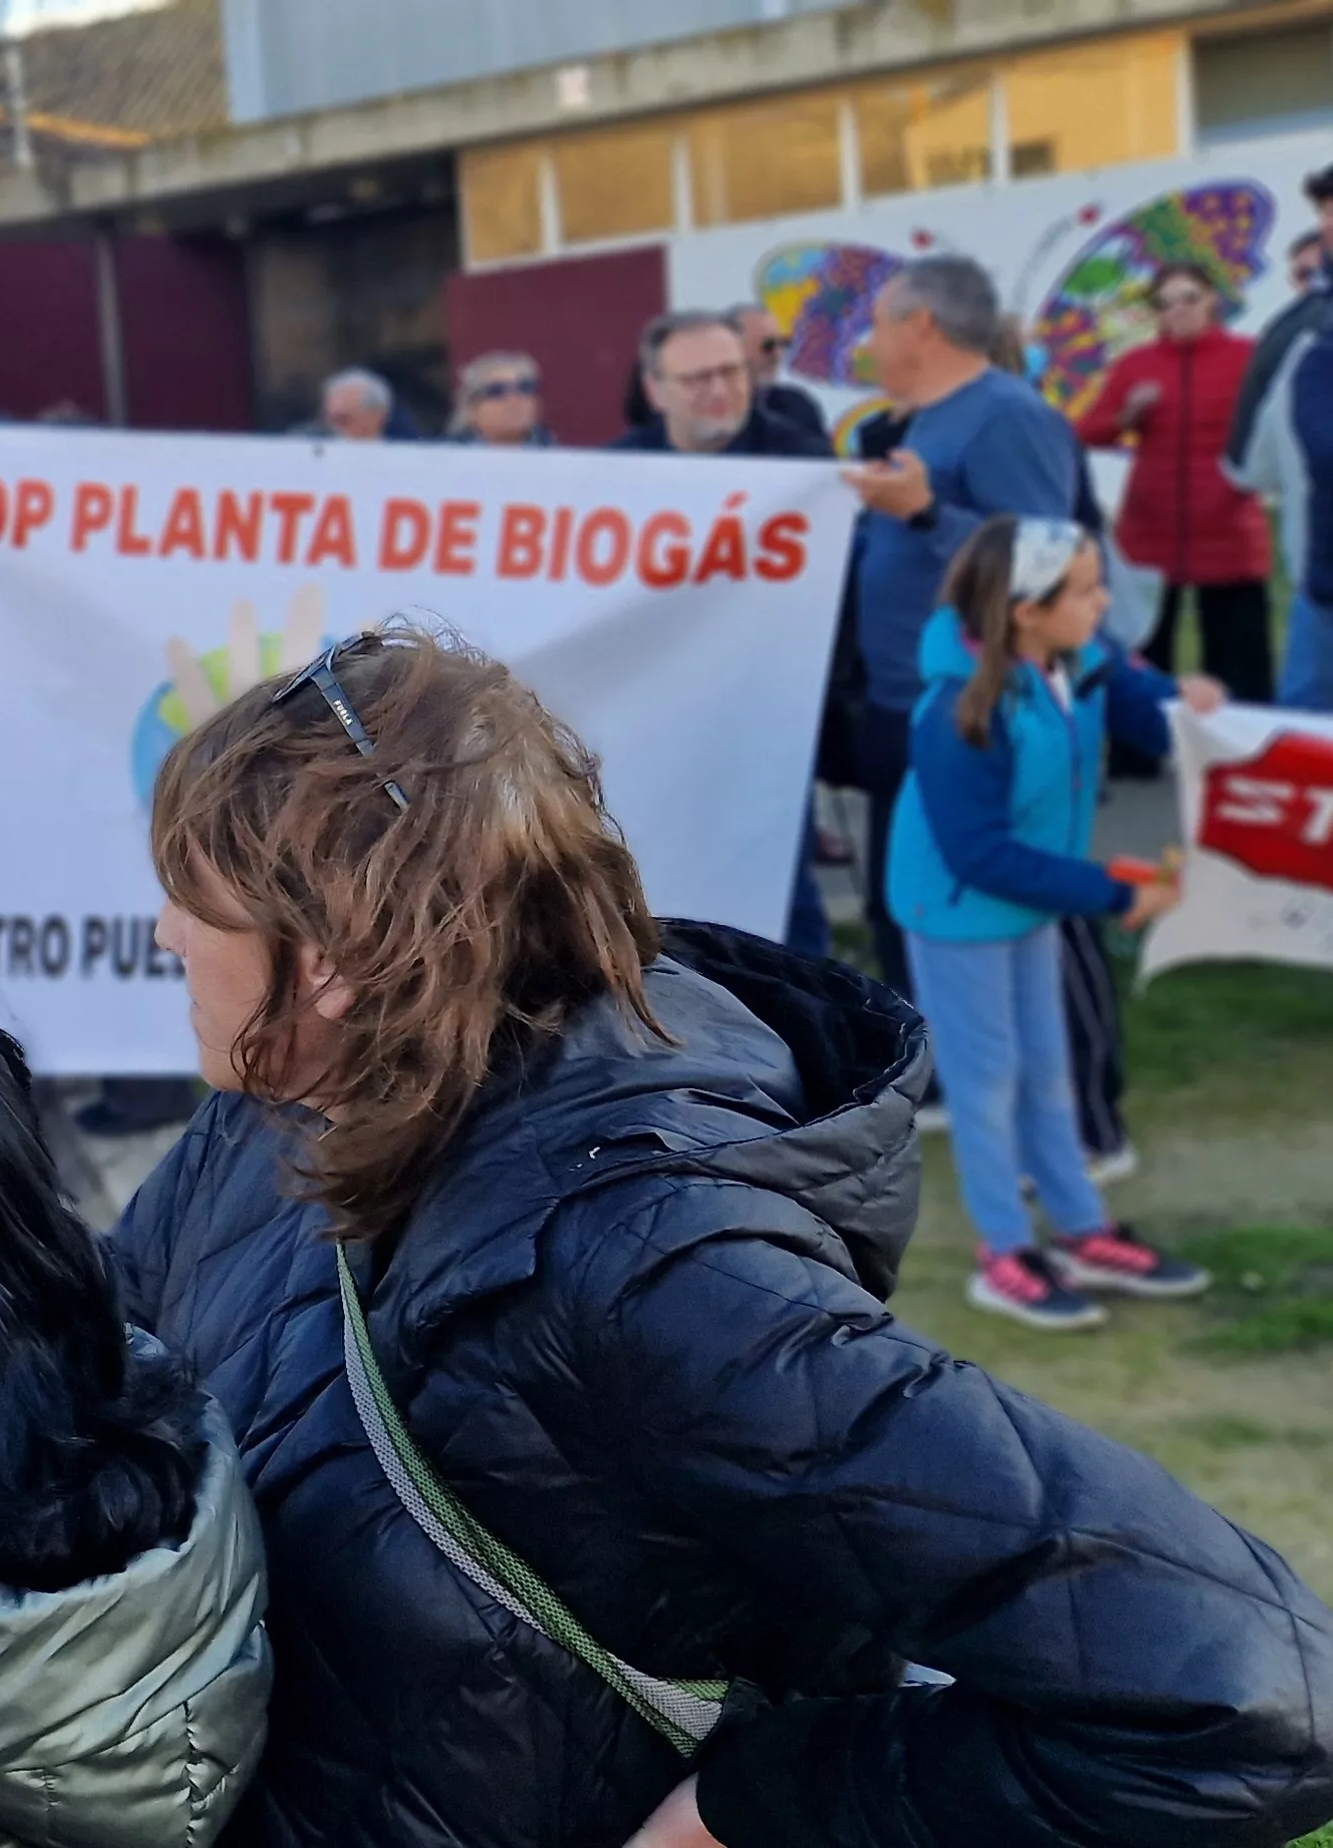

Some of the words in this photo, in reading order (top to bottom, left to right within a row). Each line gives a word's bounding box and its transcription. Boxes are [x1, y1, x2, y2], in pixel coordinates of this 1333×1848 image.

[70, 481, 357, 568] PLANTA
[377, 496, 481, 576] DE
[496, 491, 810, 591] BIOGÁS
[81, 915, 186, 980] PUE
